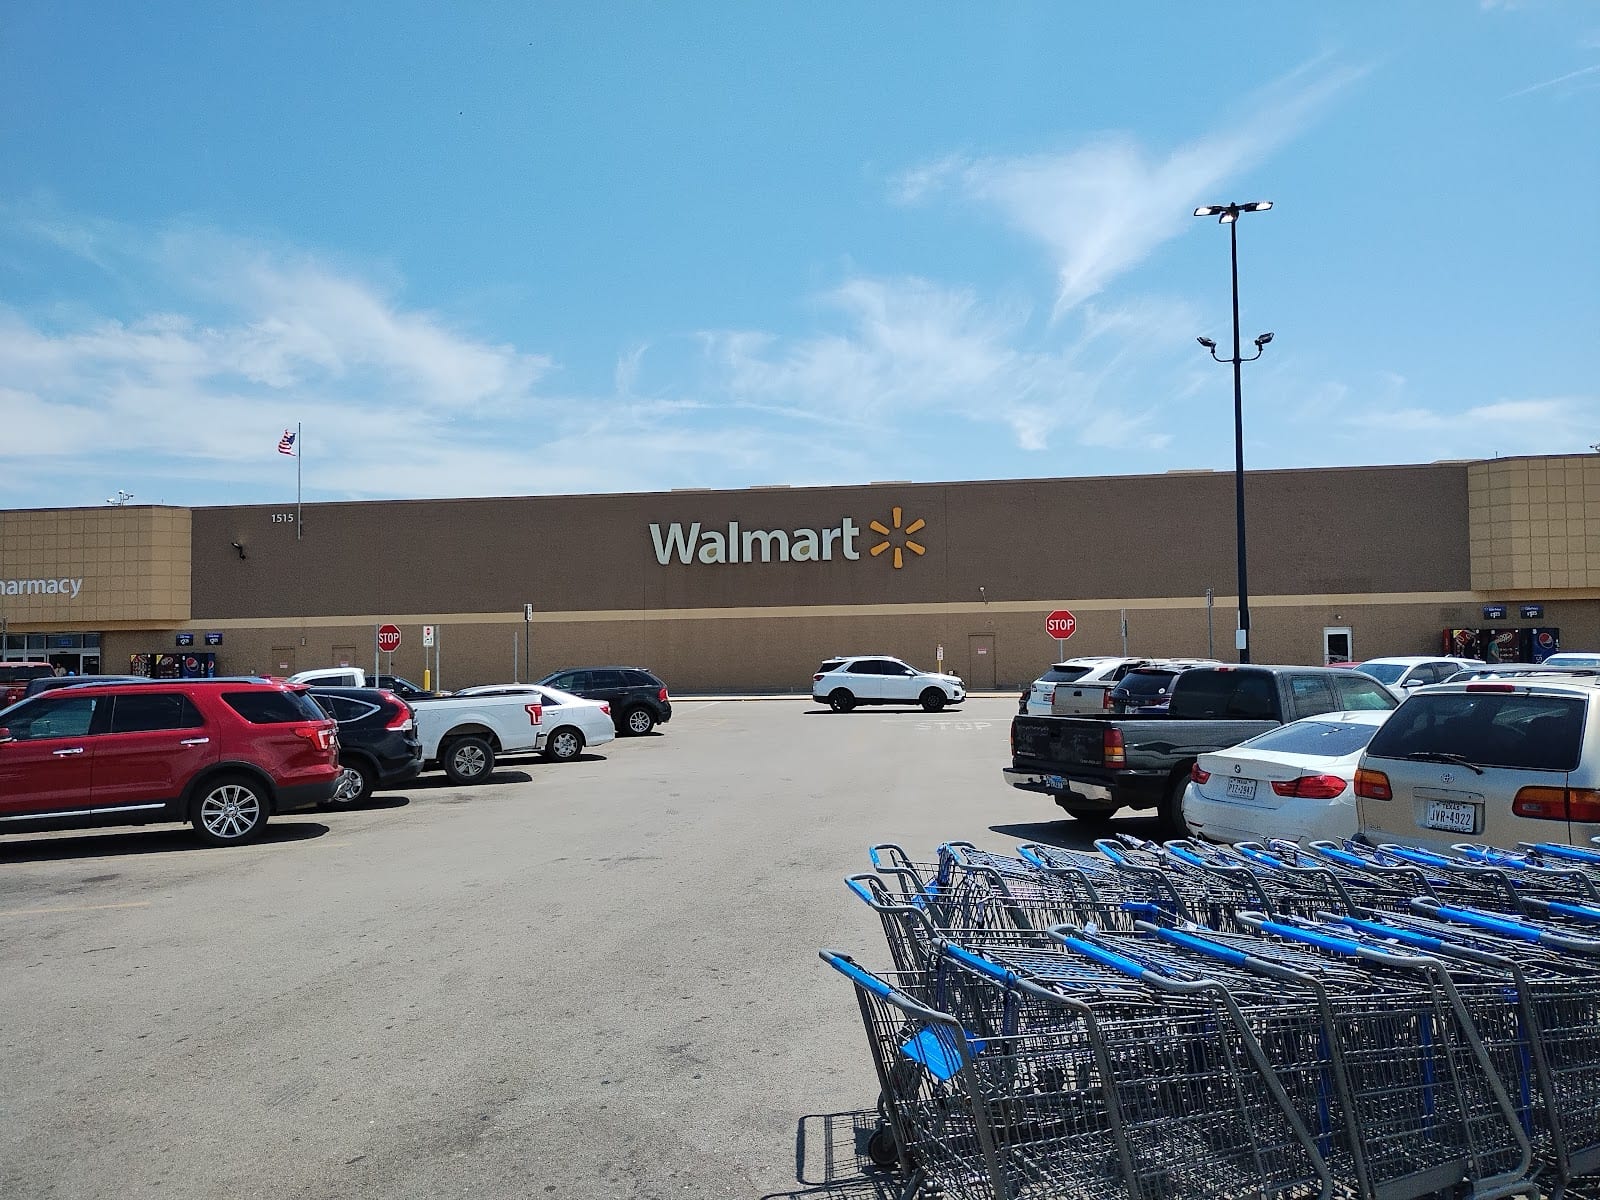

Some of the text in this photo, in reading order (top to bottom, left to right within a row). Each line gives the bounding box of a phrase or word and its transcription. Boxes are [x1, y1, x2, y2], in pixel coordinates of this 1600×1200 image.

[271, 513, 294, 523] 1515
[649, 517, 860, 565] Walmart
[1048, 619, 1074, 631] STOP
[378, 632, 400, 644] STOP
[914, 721, 993, 731] STOP
